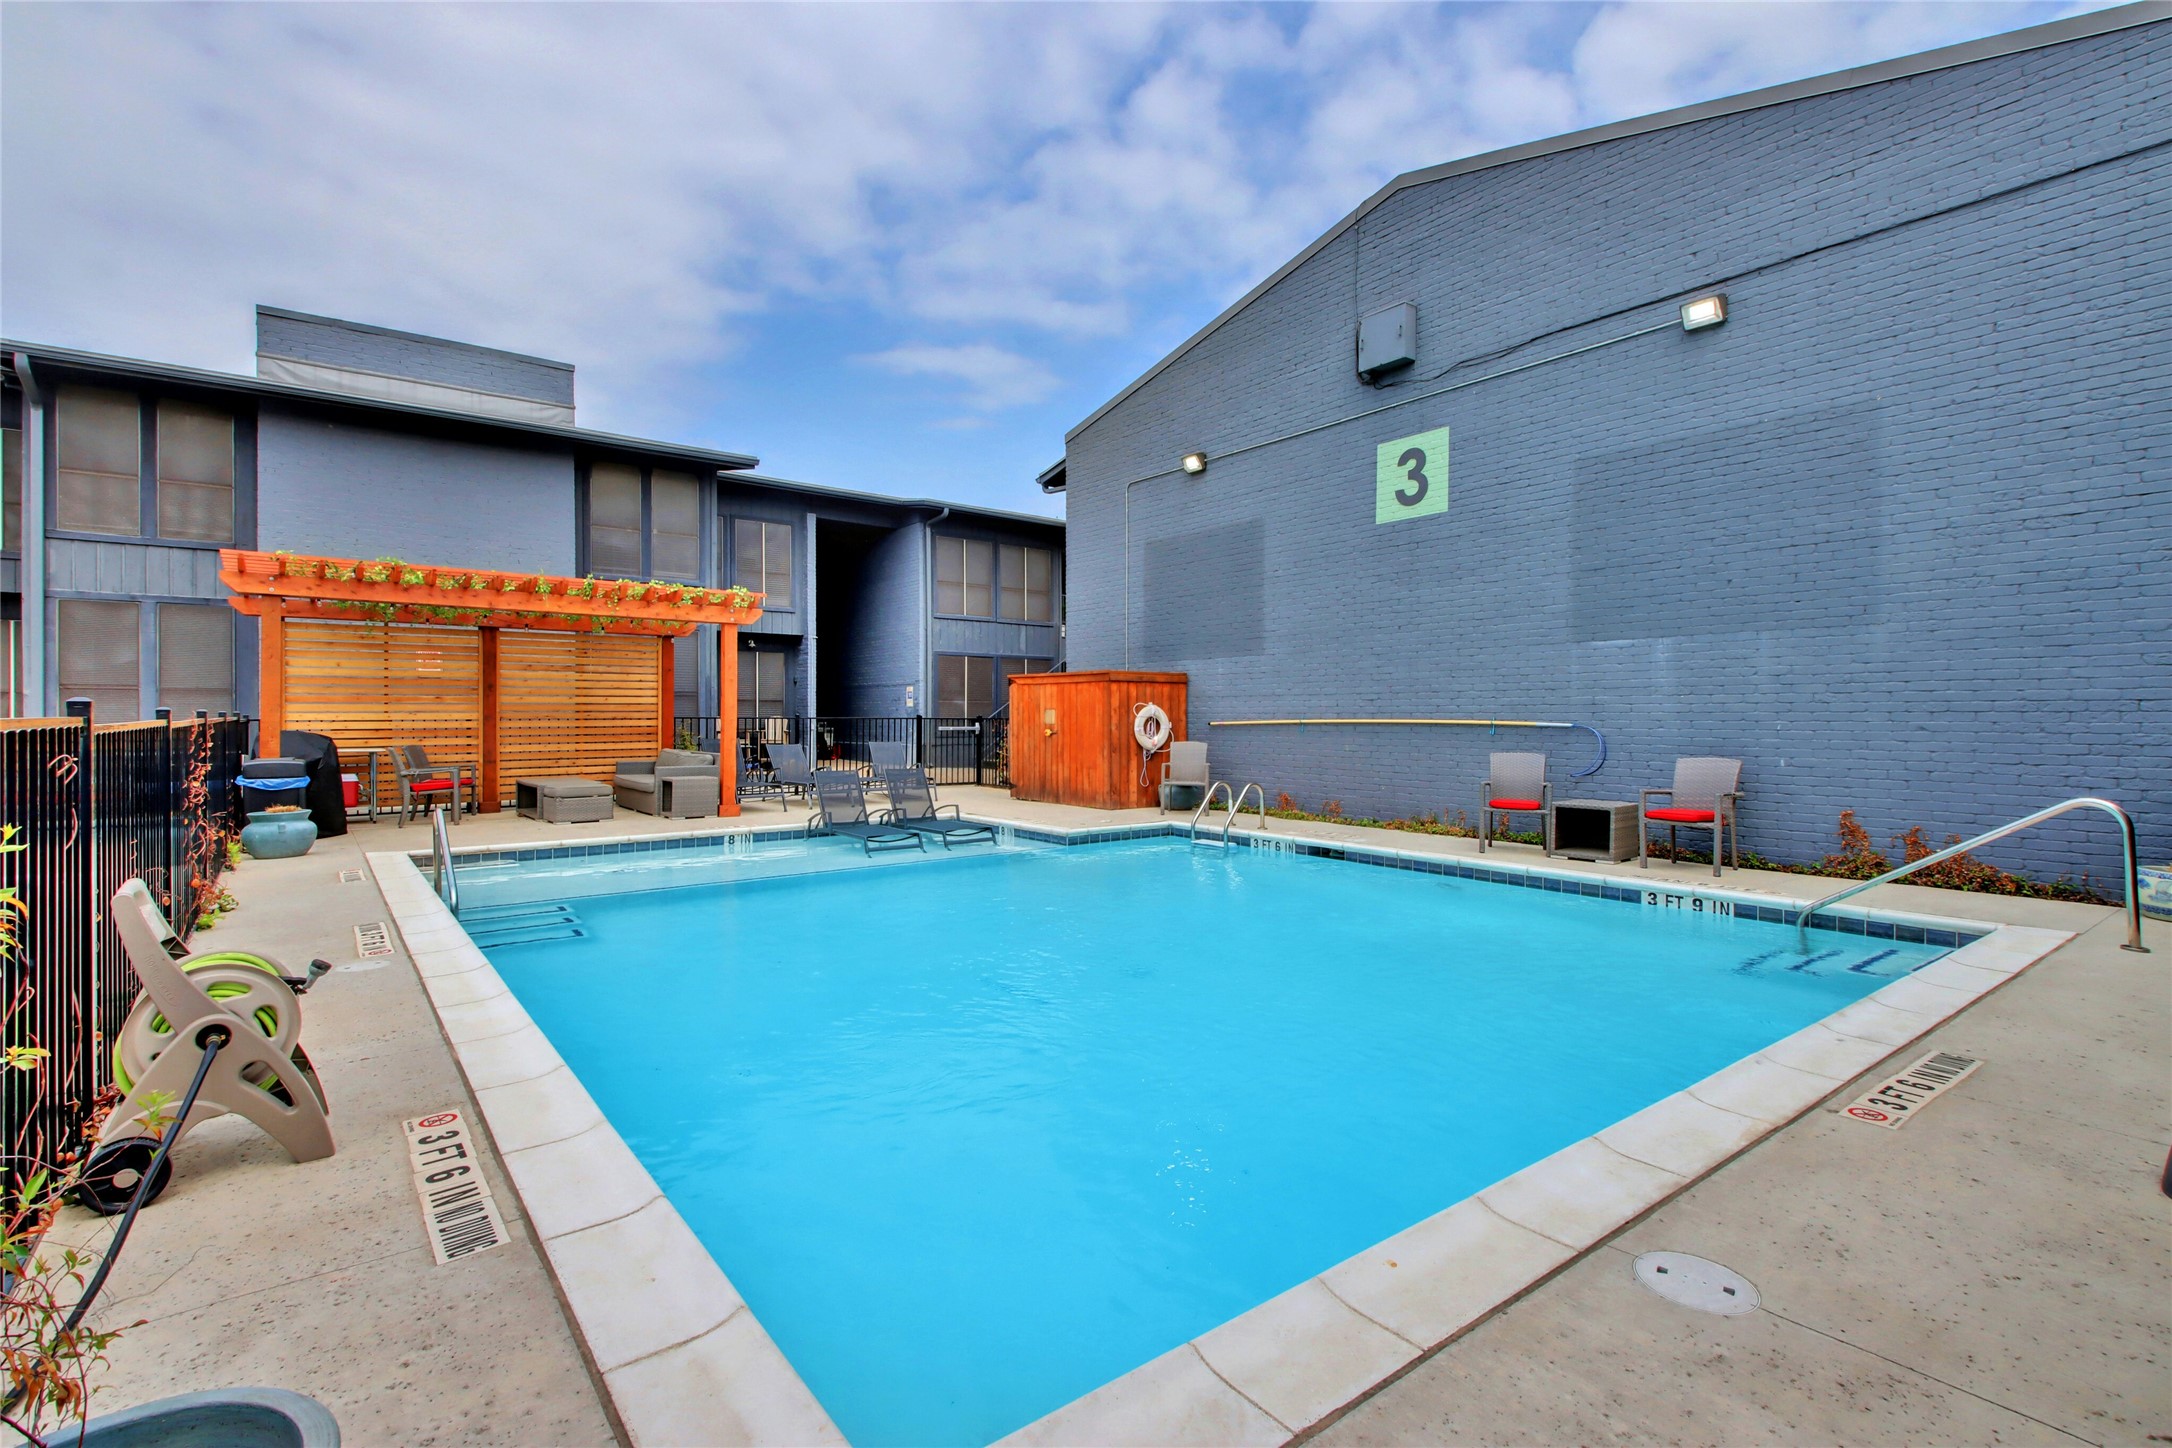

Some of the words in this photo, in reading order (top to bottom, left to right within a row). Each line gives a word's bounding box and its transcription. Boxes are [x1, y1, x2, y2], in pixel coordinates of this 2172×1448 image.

[1394, 447, 1429, 507] 3
[728, 834, 735, 845] 8
[740, 833, 751, 845] IN
[1253, 838, 1259, 849] 3
[1262, 839, 1271, 850] FT
[1275, 841, 1281, 852] 6
[1284, 842, 1294, 854] IN
[1647, 892, 1658, 906] 3
[1665, 894, 1684, 909] FT
[1692, 898, 1703, 912] 9
[1712, 900, 1730, 916] IN
[1895, 1079, 1936, 1091] 6
[1907, 1068, 1953, 1085] IN
[1867, 1096, 1909, 1111] 3
[1877, 1085, 1925, 1104] FT
[418, 1130, 460, 1145] 3
[419, 1142, 468, 1166] FT
[425, 1165, 471, 1184] 6
[428, 1181, 481, 1209] IN
[433, 1200, 485, 1224] NO
[438, 1214, 499, 1259] DIVING
